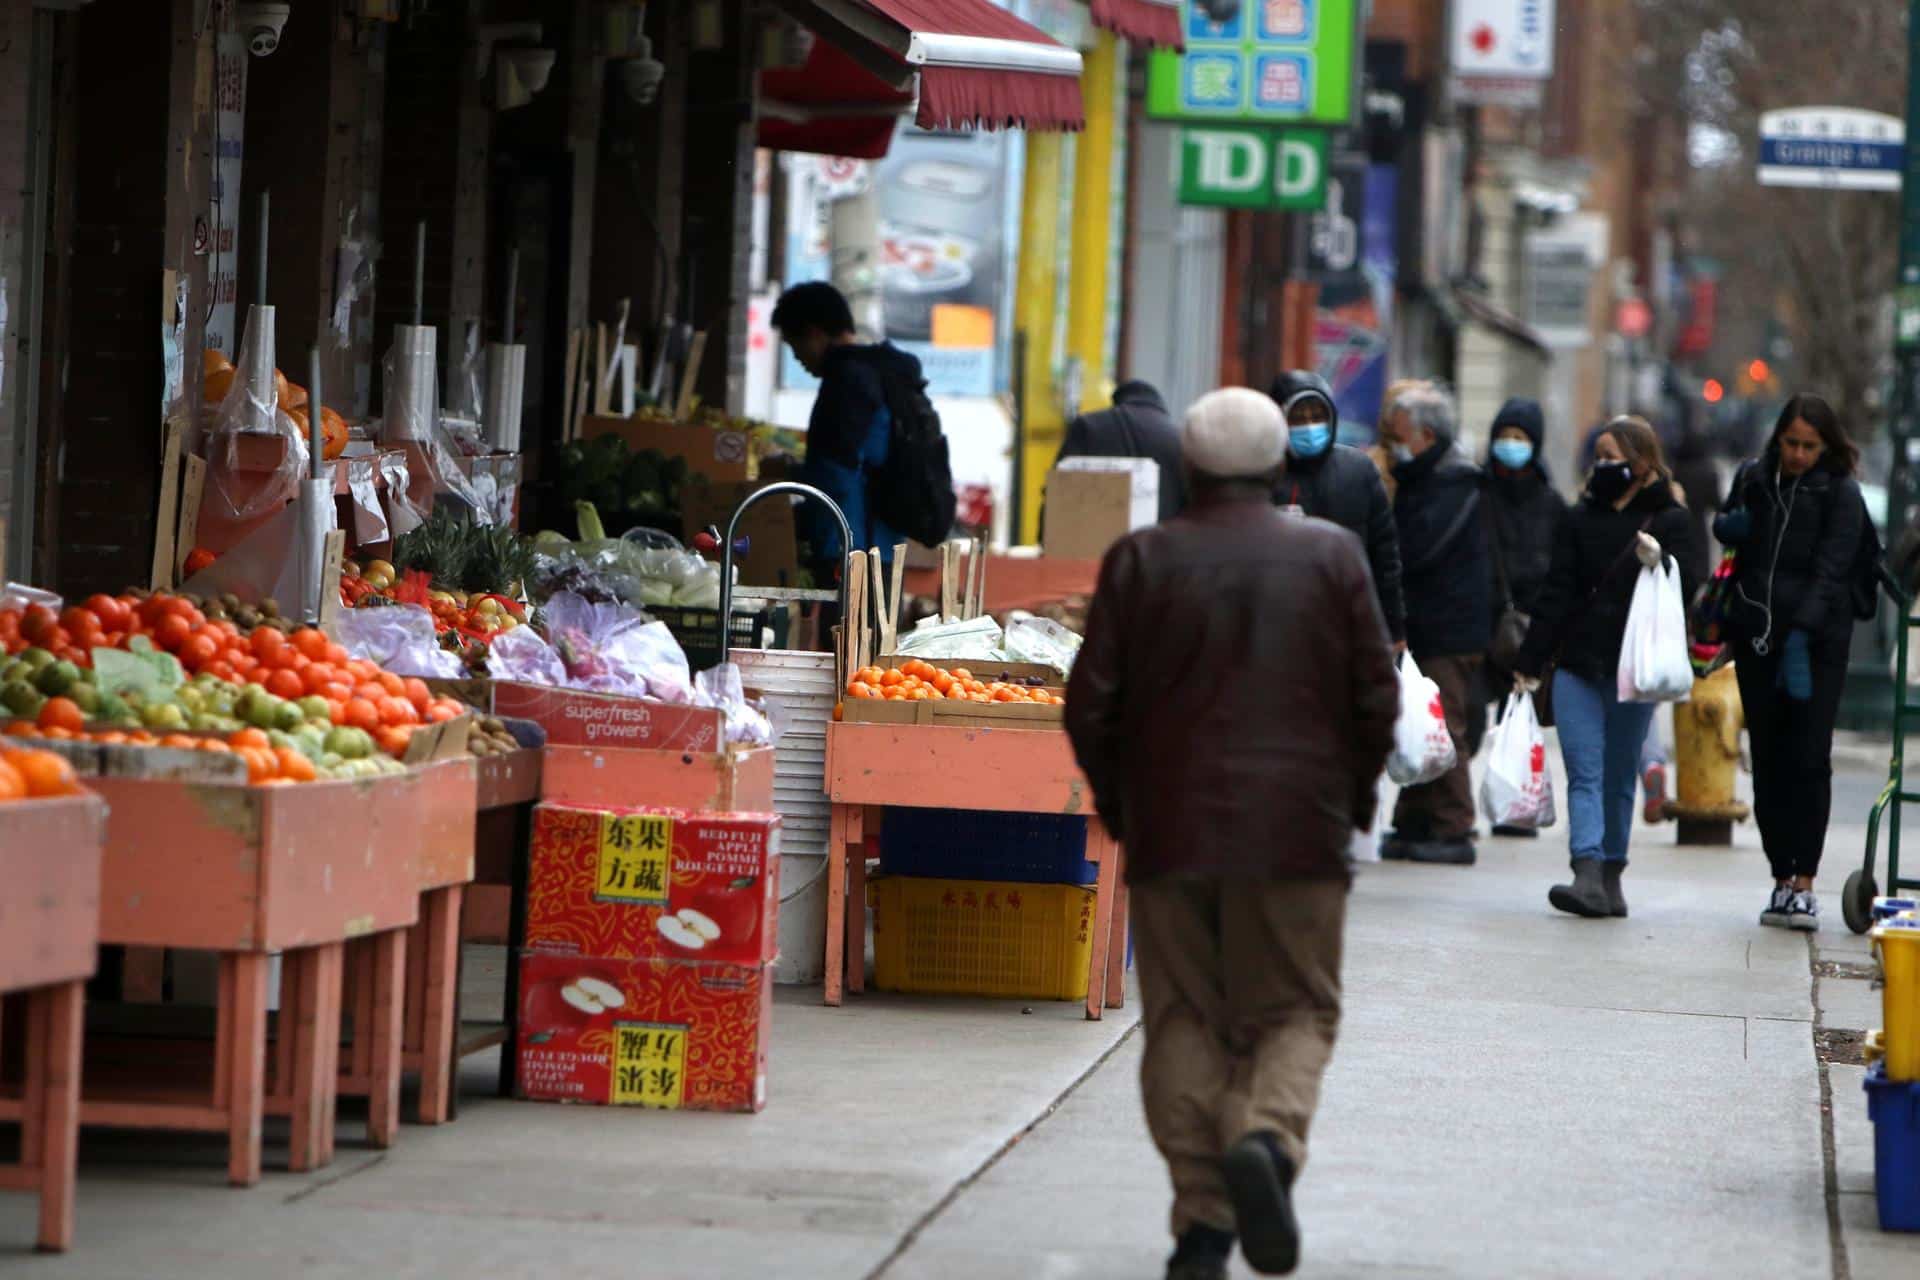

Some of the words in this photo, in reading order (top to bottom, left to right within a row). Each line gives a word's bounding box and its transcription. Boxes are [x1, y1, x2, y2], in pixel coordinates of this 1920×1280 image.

[1188, 130, 1268, 191] TD
[565, 704, 650, 725] superfresh
[586, 720, 649, 739] growers
[699, 829, 728, 840] RED
[731, 830, 762, 842] FUJI
[717, 842, 761, 853] APPLE
[706, 851, 761, 864] POMME
[675, 859, 725, 873] ROUGE
[729, 864, 760, 875] FUJI
